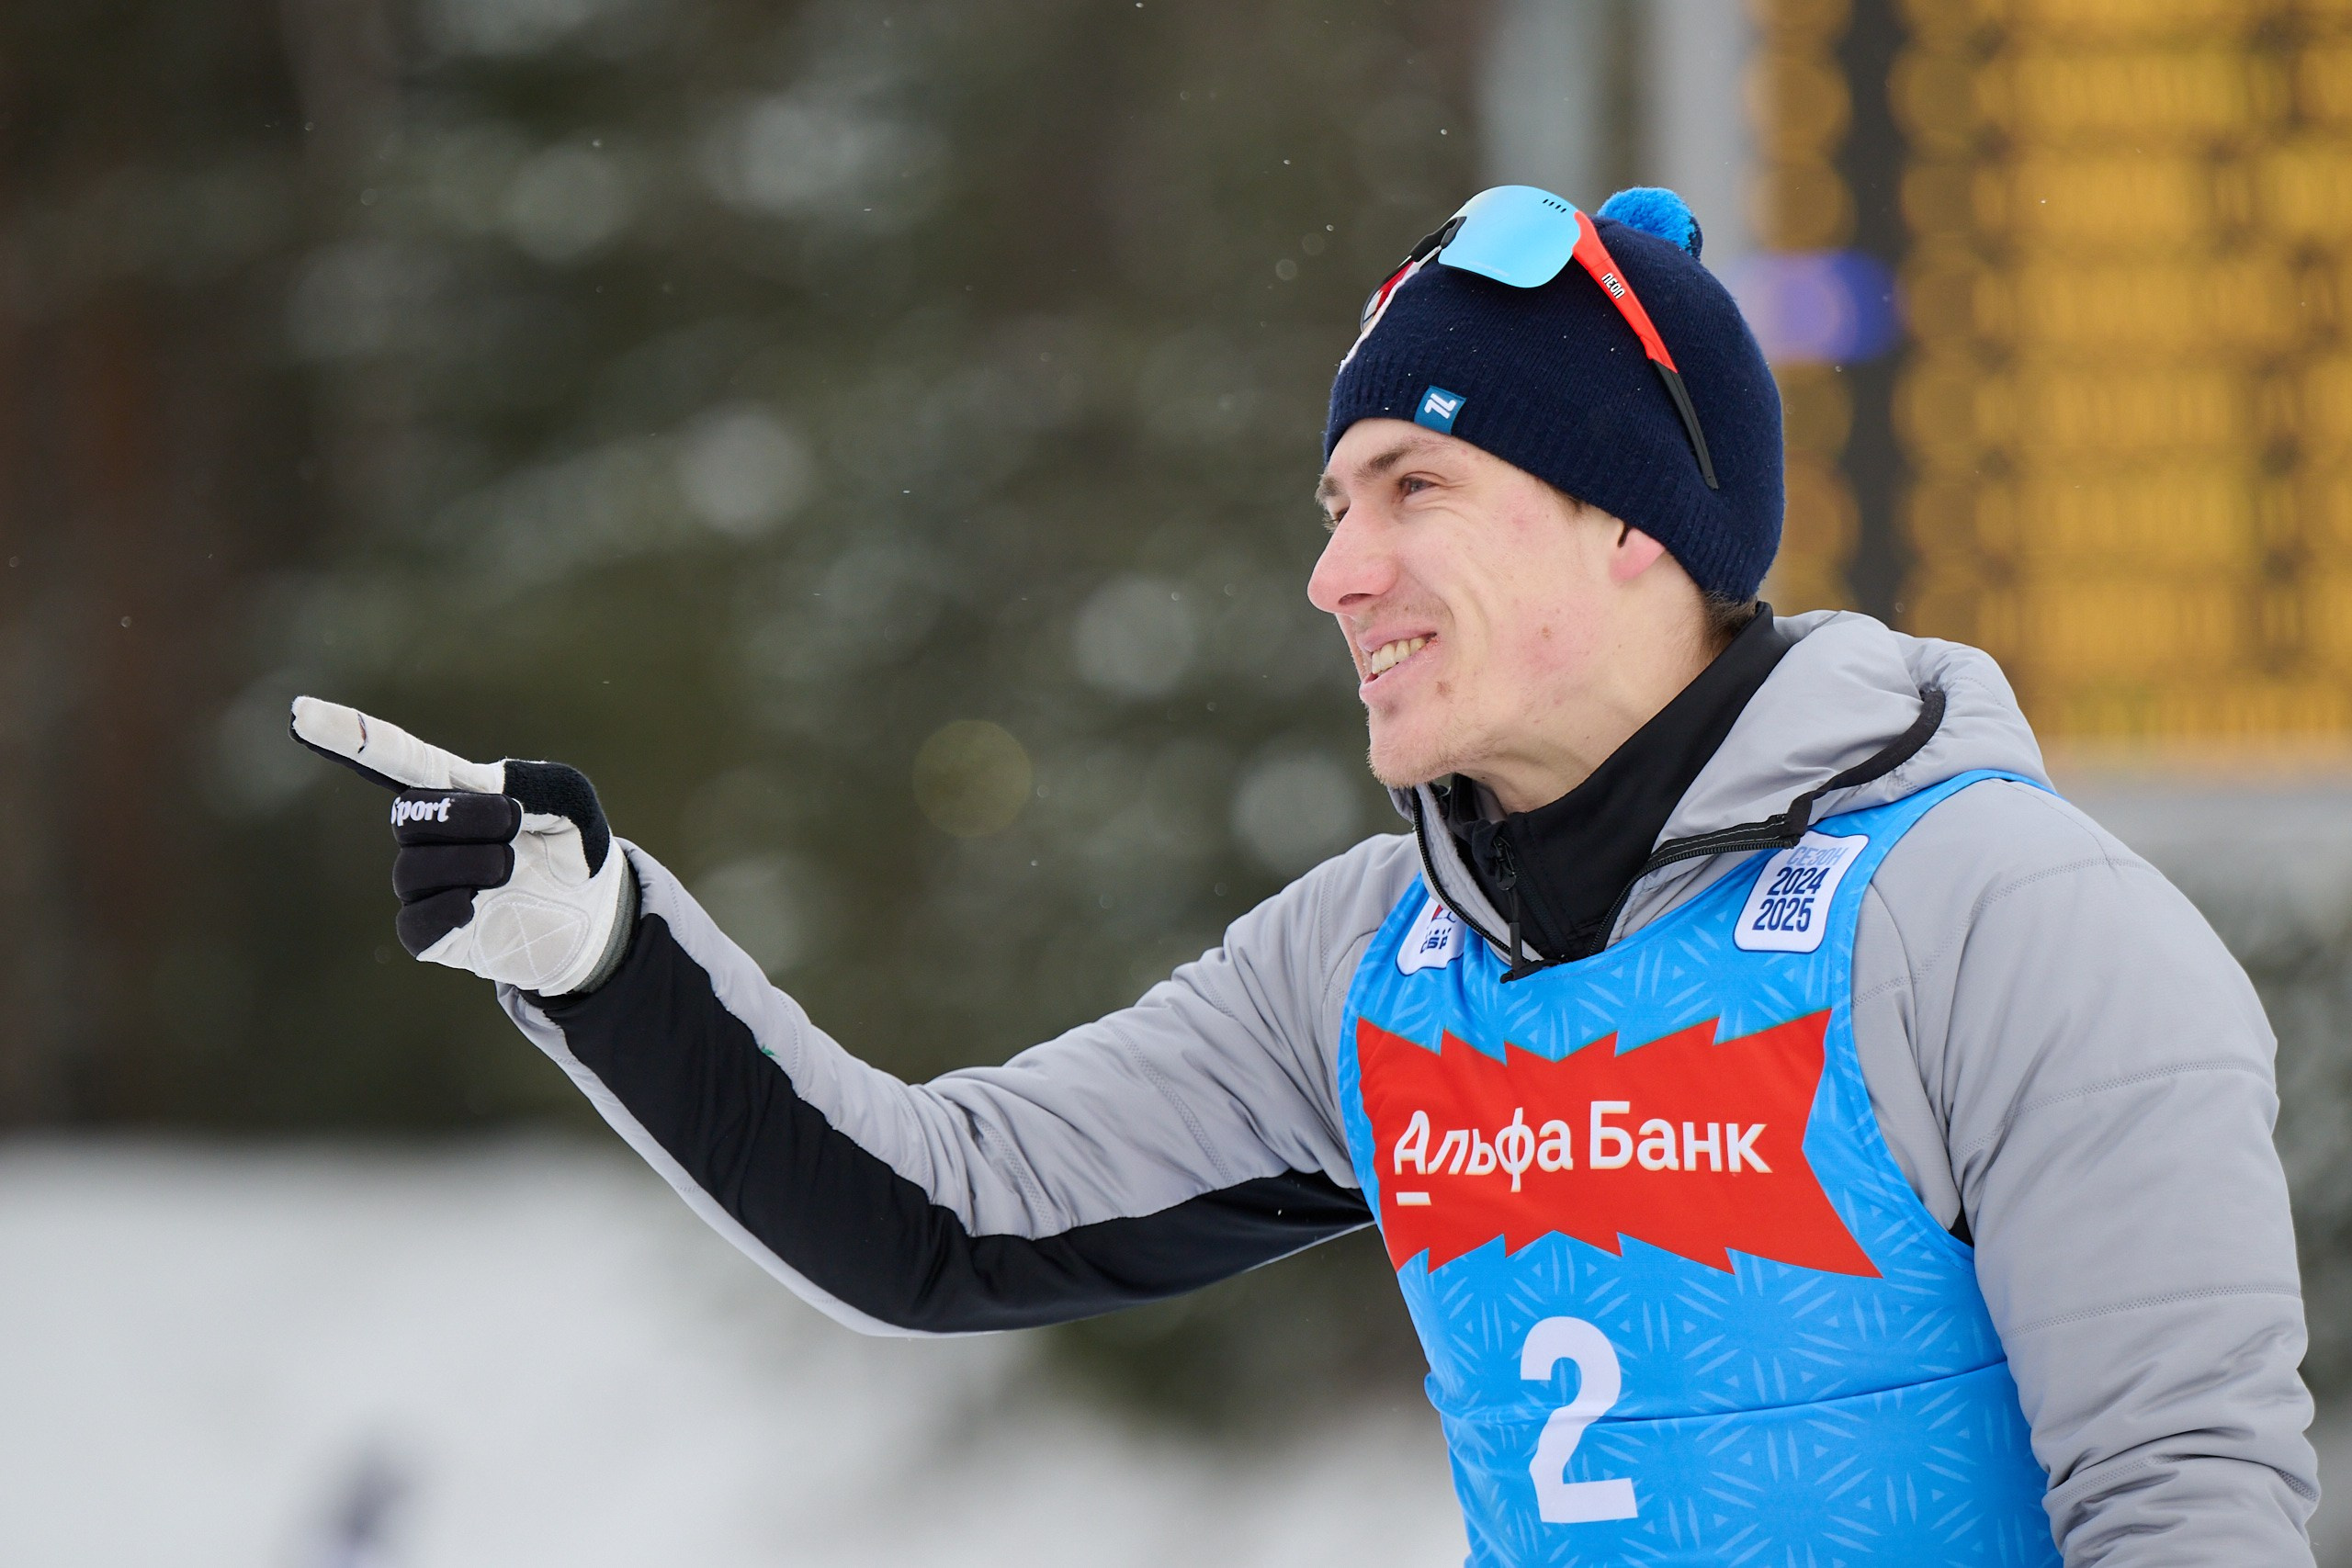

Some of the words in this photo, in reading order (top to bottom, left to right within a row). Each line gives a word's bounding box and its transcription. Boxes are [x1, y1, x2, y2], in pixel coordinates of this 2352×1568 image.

[1786, 846, 1849, 866] СЕЗОН
[1767, 866, 1830, 896] 2024
[1752, 897, 1815, 932] 2025
[1393, 1107, 1573, 1192] Альфа
[1589, 1100, 1773, 1174] Банк
[1520, 1315, 1638, 1523] 2
